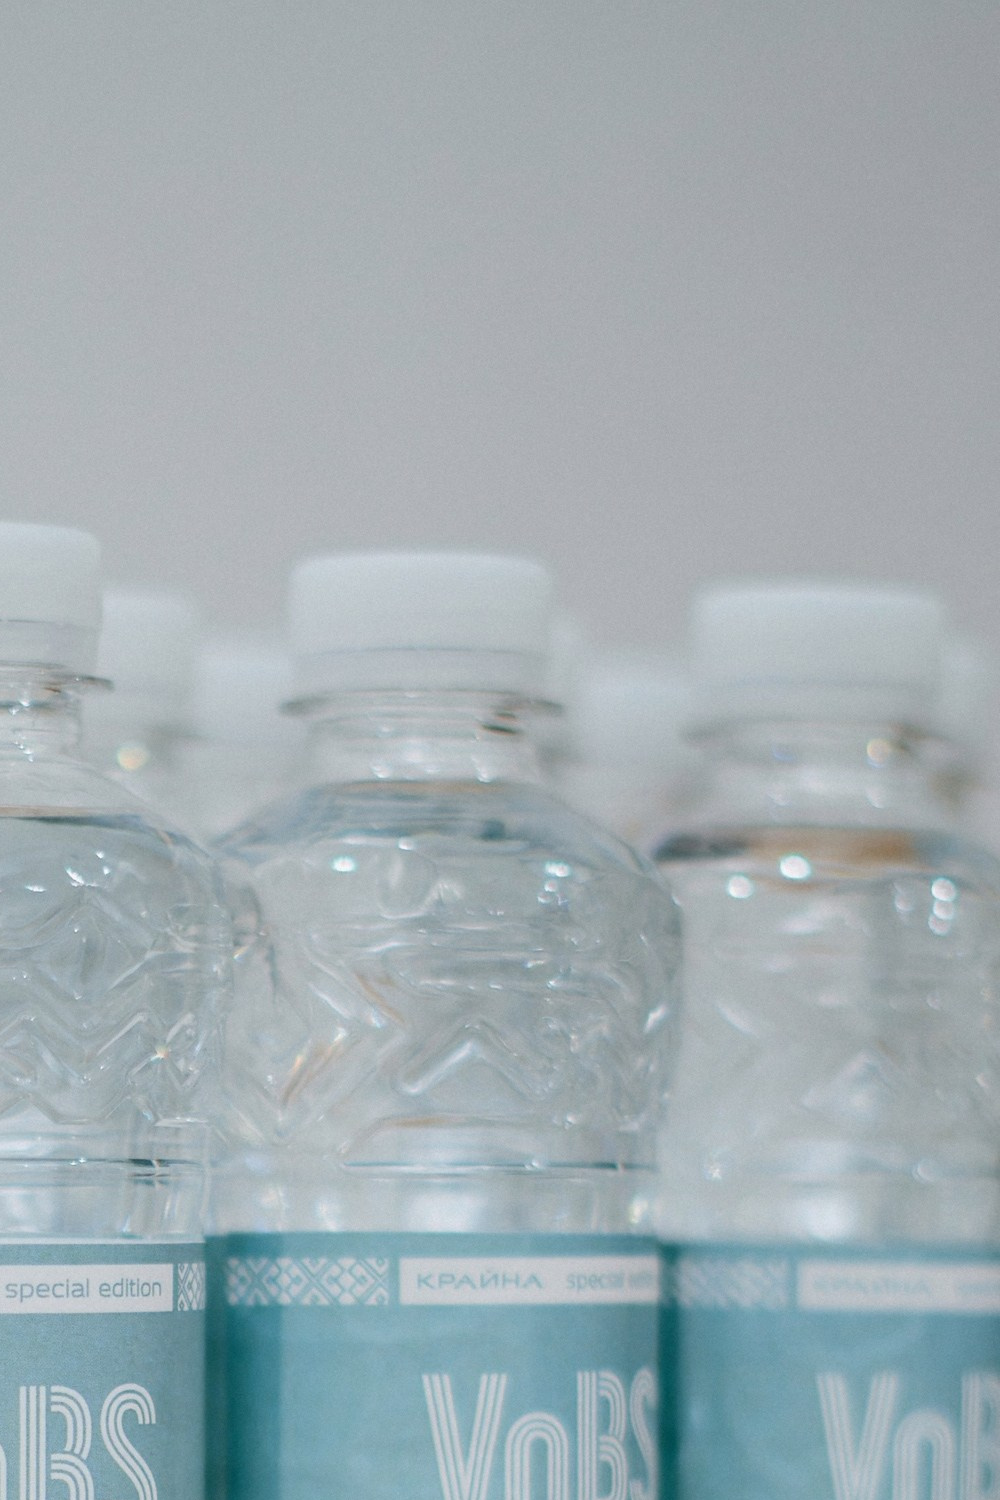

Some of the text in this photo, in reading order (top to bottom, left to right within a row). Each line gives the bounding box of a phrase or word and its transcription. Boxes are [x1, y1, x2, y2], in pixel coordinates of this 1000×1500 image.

[4, 1277, 162, 1303] special edition
[416, 1265, 544, 1290] КРАЙНА
